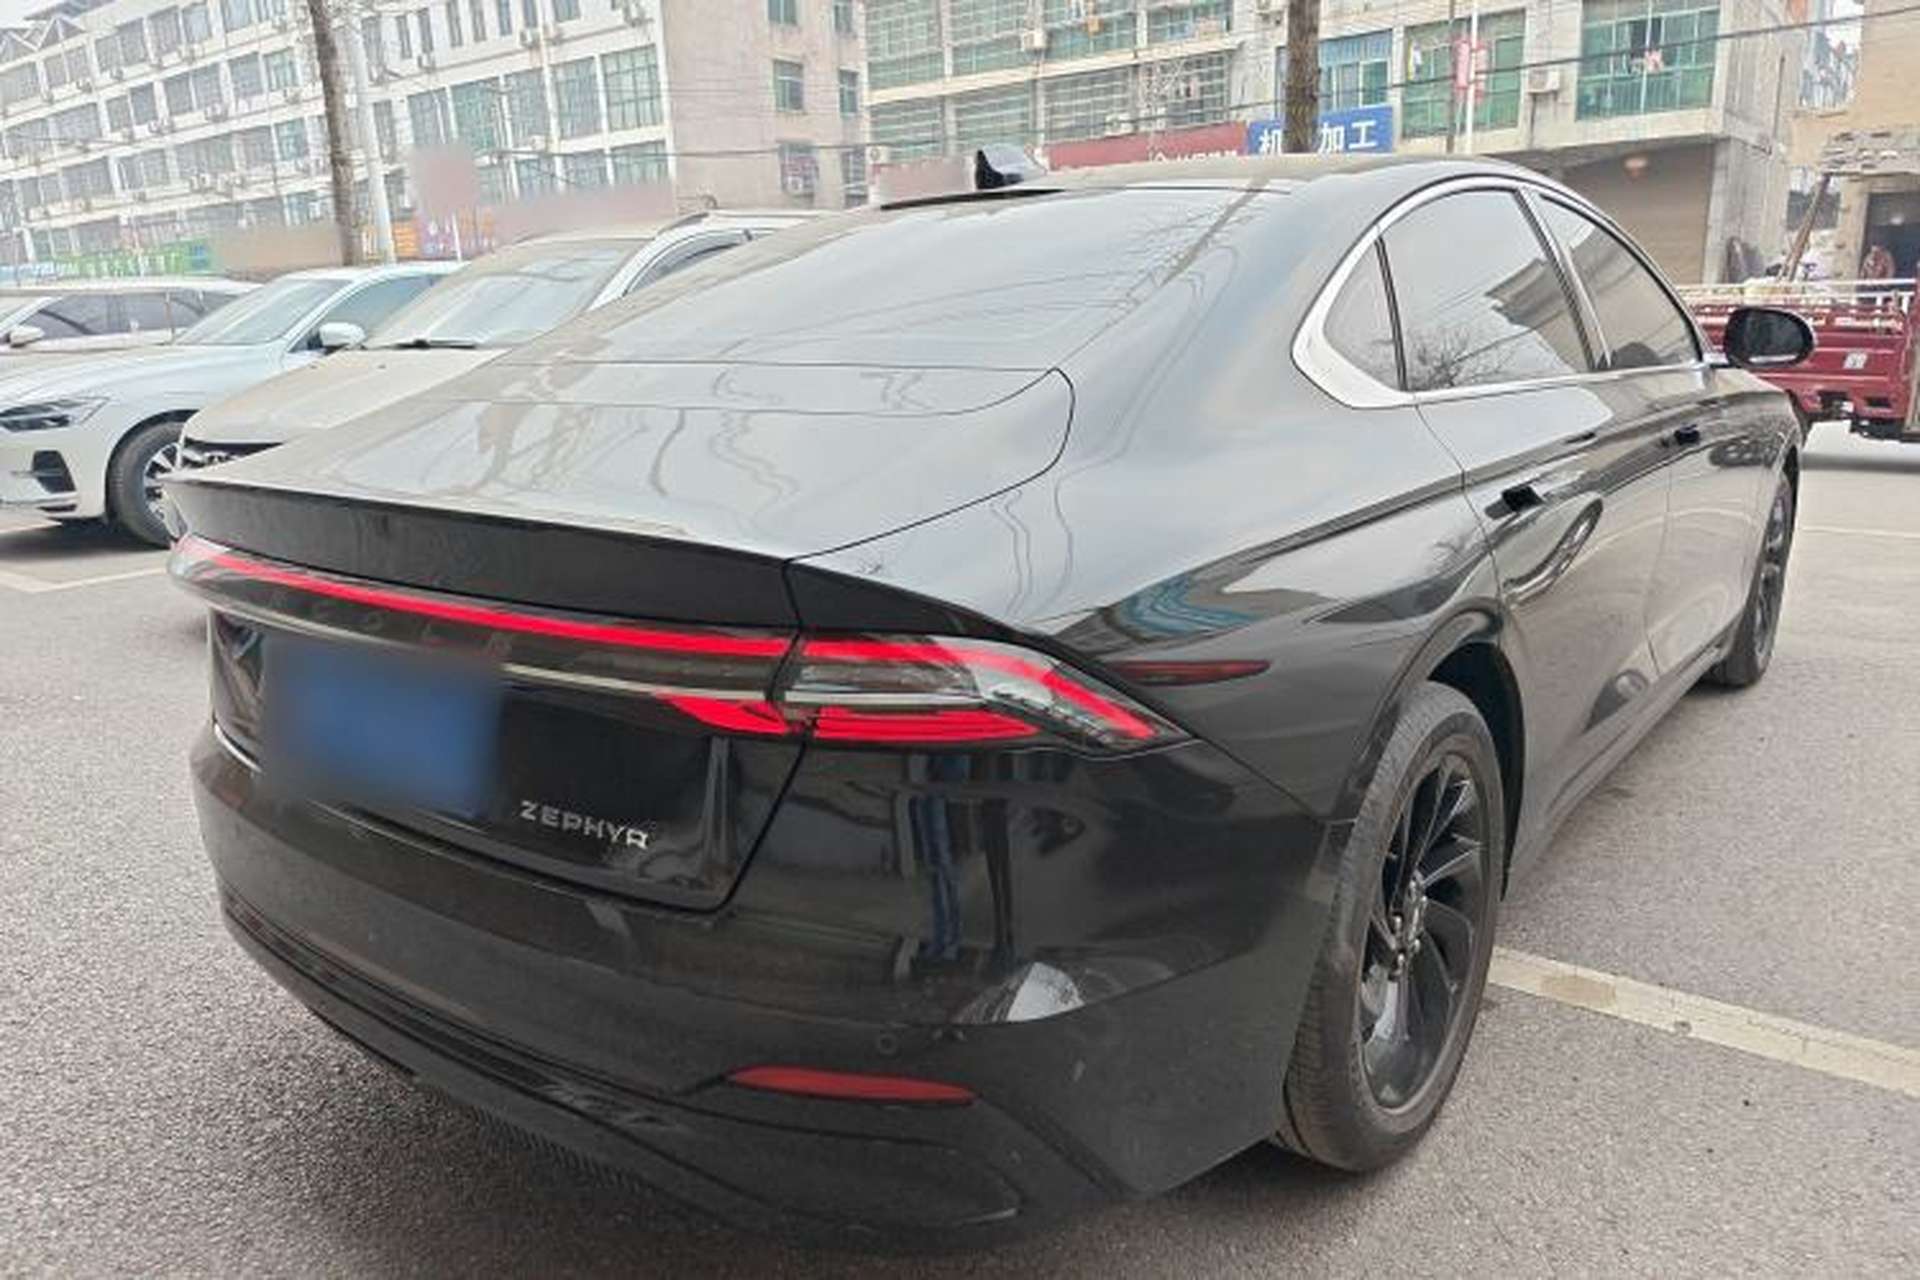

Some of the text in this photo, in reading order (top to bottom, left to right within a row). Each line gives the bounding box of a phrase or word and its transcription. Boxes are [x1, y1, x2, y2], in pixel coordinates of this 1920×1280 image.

[1259, 120, 1377, 154] 机加工
[520, 800, 648, 849] ZEPHYR
